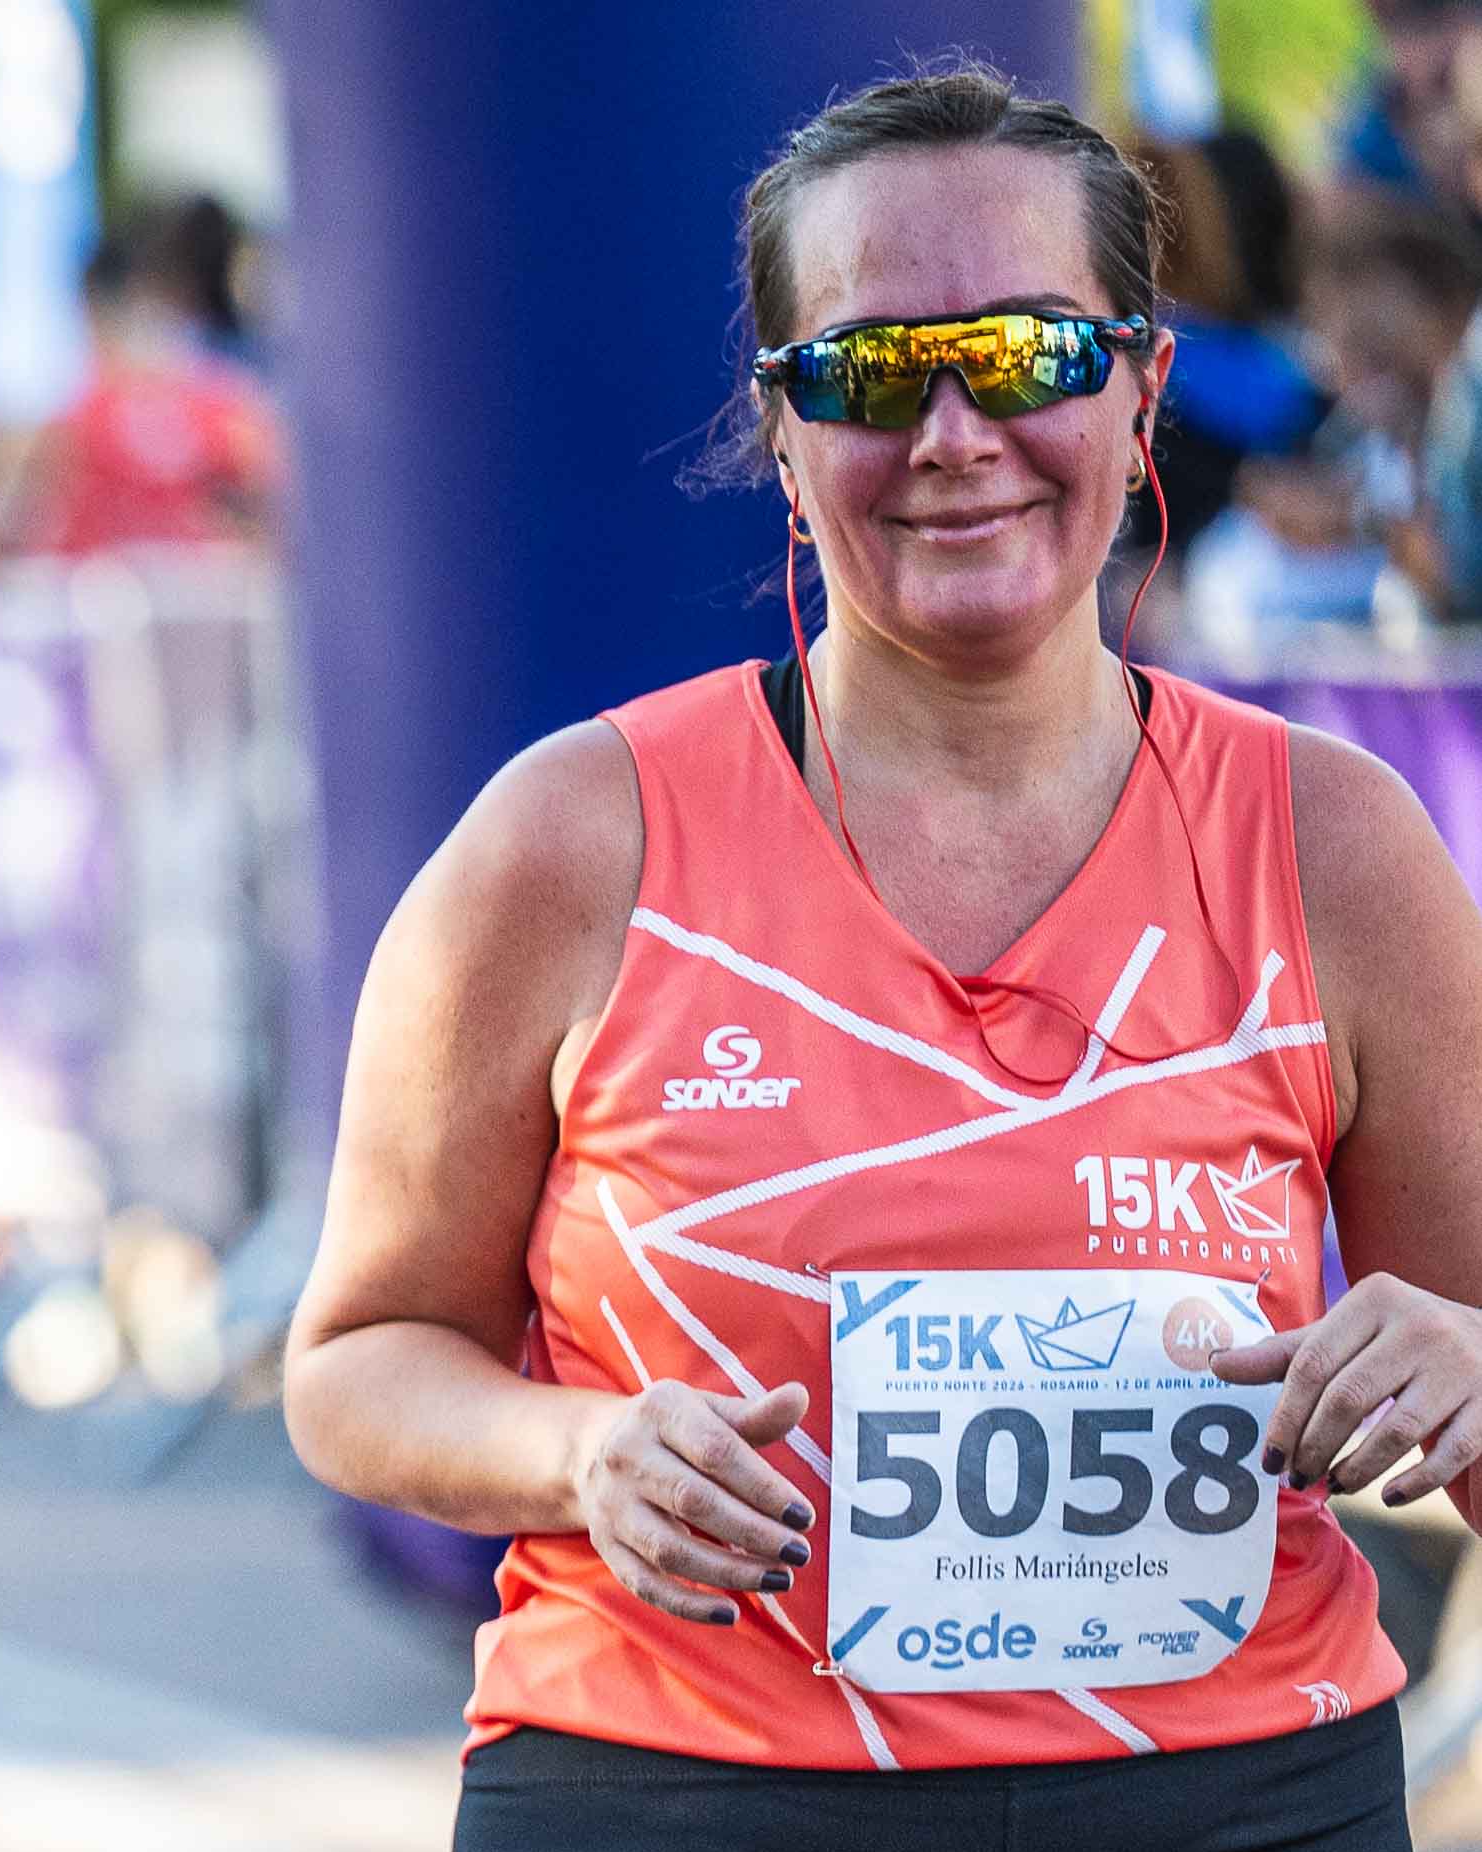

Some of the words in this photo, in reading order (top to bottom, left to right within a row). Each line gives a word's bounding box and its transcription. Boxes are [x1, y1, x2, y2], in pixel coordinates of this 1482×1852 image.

[1075, 1155, 1208, 1232] 15K
[1088, 1235, 1210, 1258] PUERTO
[885, 1314, 1005, 1371] 15K
[1176, 1318, 1220, 1350] 4K
[885, 1379, 938, 1392] PUERTO
[944, 1379, 987, 1392] NORTE
[1040, 1379, 1099, 1391] ROSARIO
[1135, 1378, 1150, 1389] DE
[1156, 1377, 1193, 1389] ABRIL
[849, 1403, 1260, 1540] 5058
[935, 1554, 1005, 1580] Follis
[1015, 1552, 1168, 1584] Mariángeles
[896, 1611, 1037, 1664] osde
[1138, 1631, 1200, 1645] POWER
